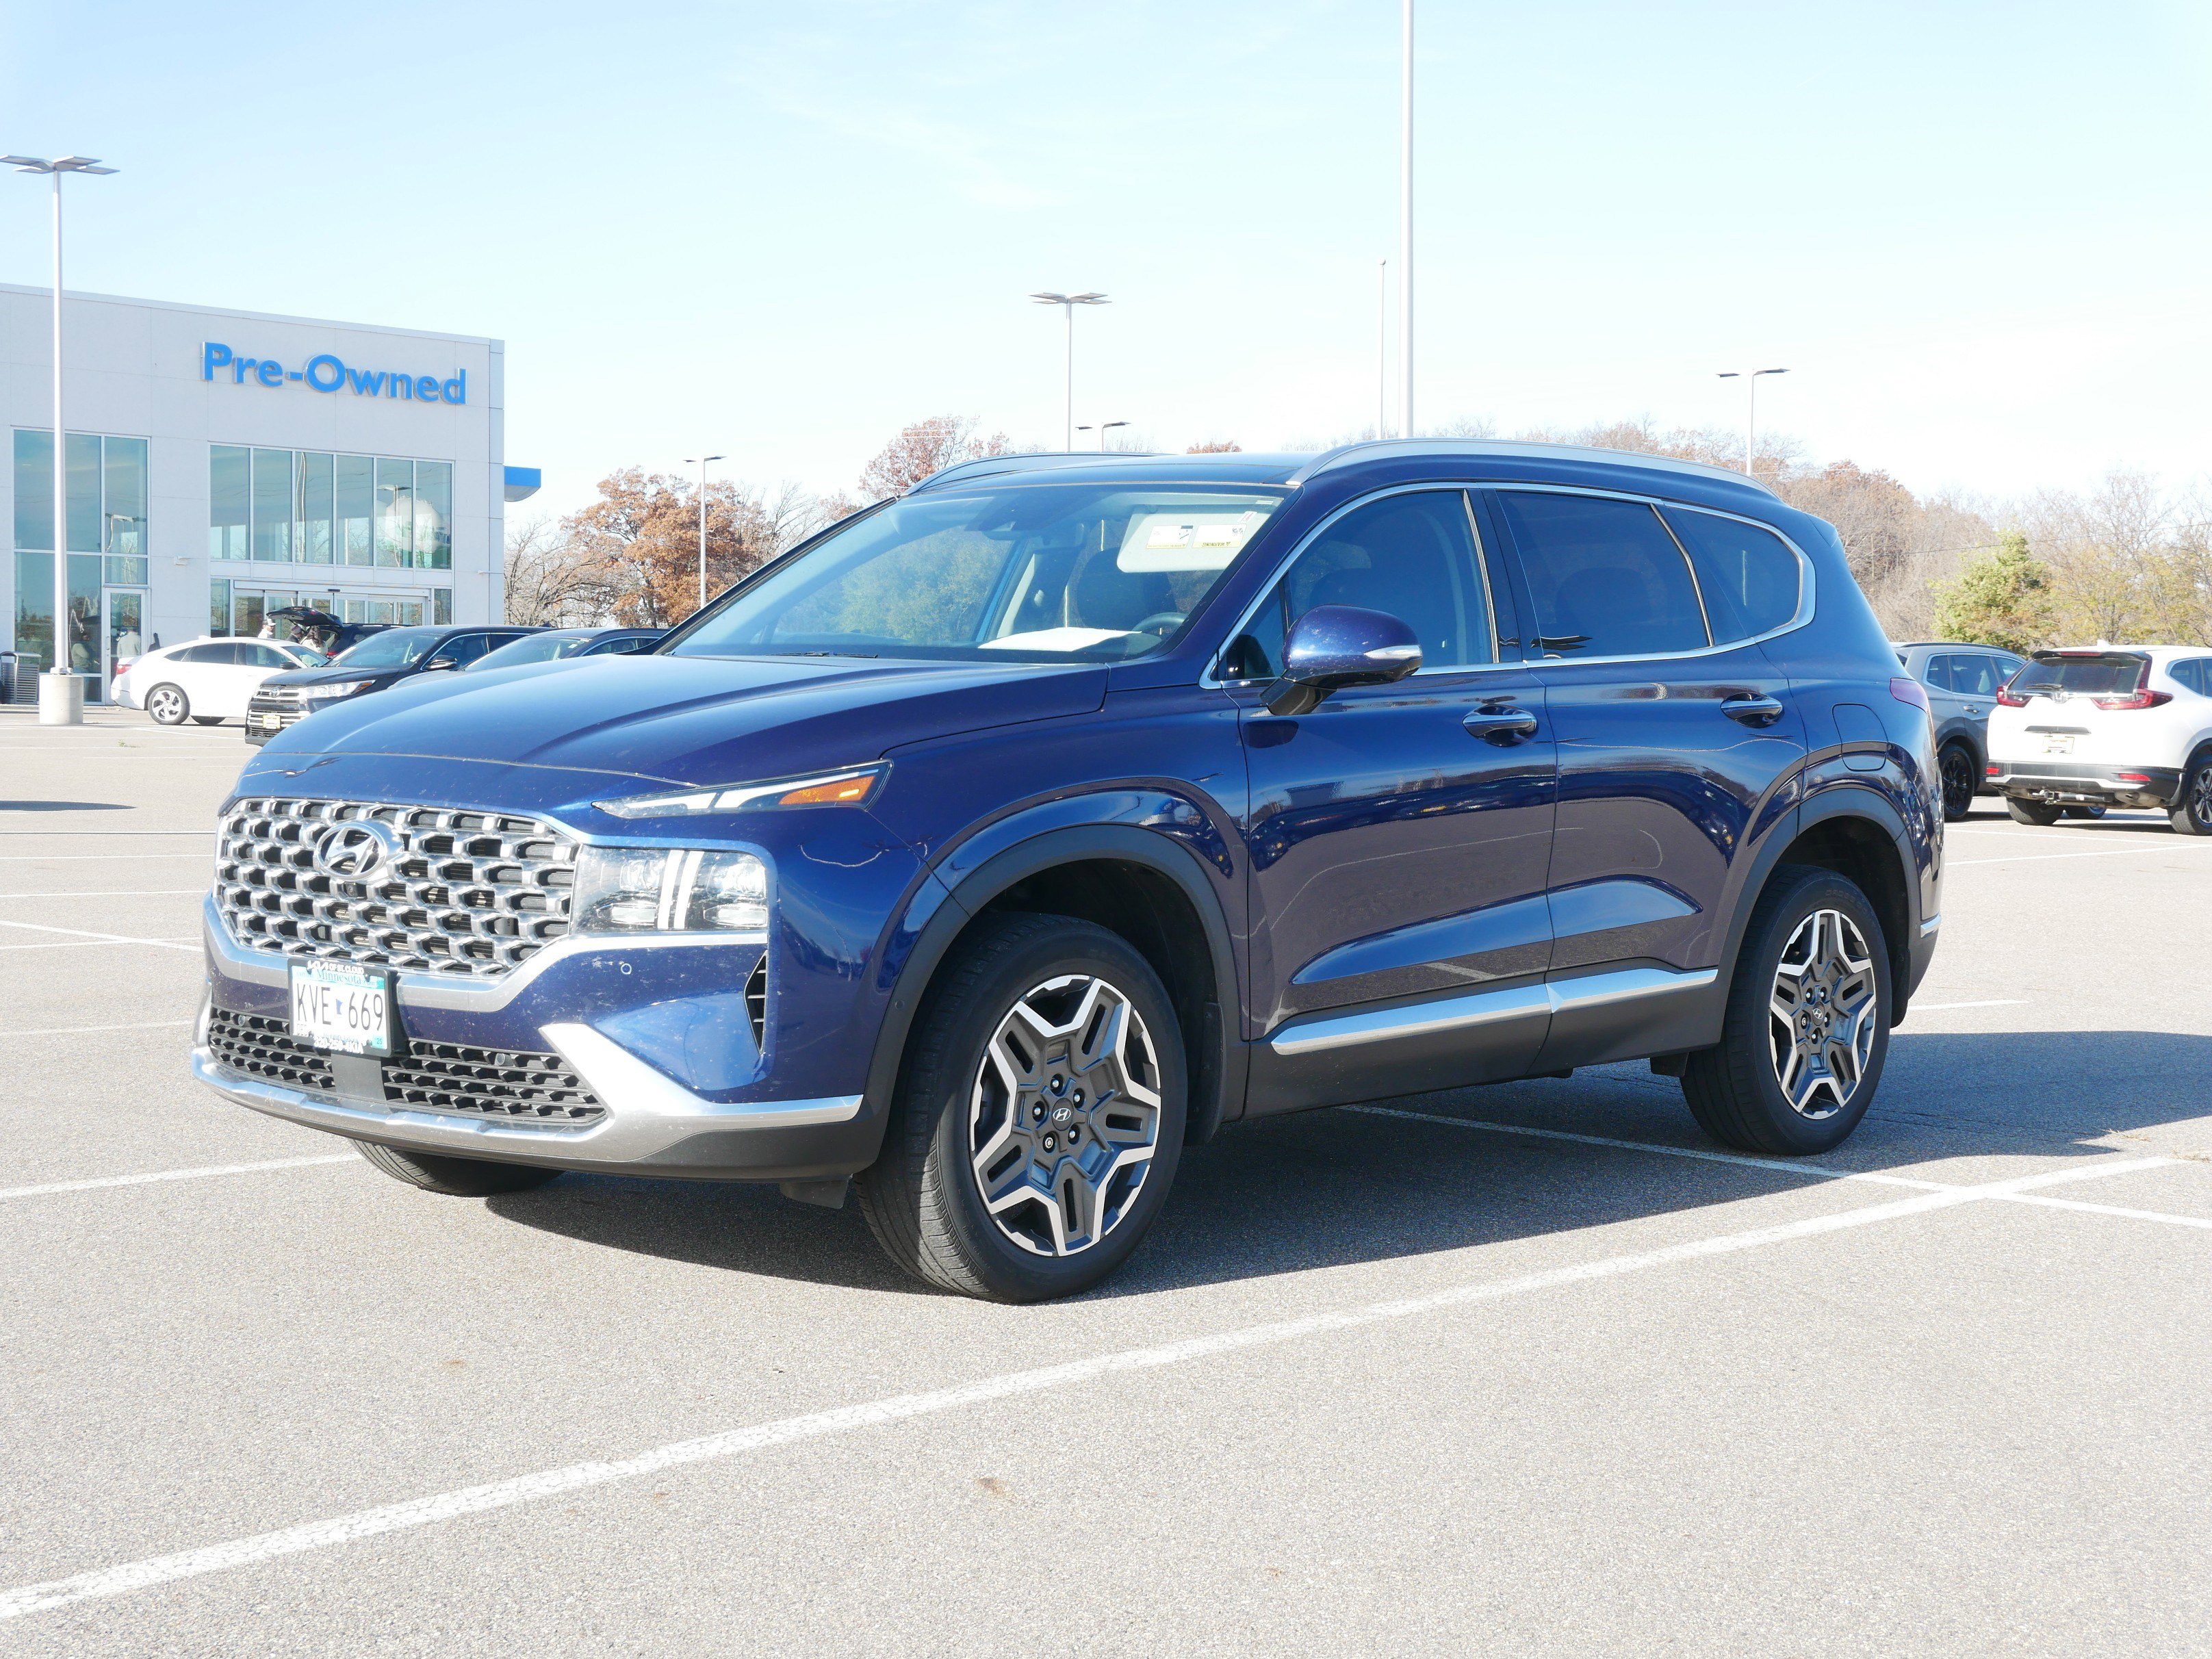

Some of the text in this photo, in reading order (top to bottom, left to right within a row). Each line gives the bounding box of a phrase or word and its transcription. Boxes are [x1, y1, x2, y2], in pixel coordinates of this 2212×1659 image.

[201, 342, 467, 404] Pre-Owned
[318, 970, 361, 984] Minnesota
[296, 983, 383, 1031] KVE 669
